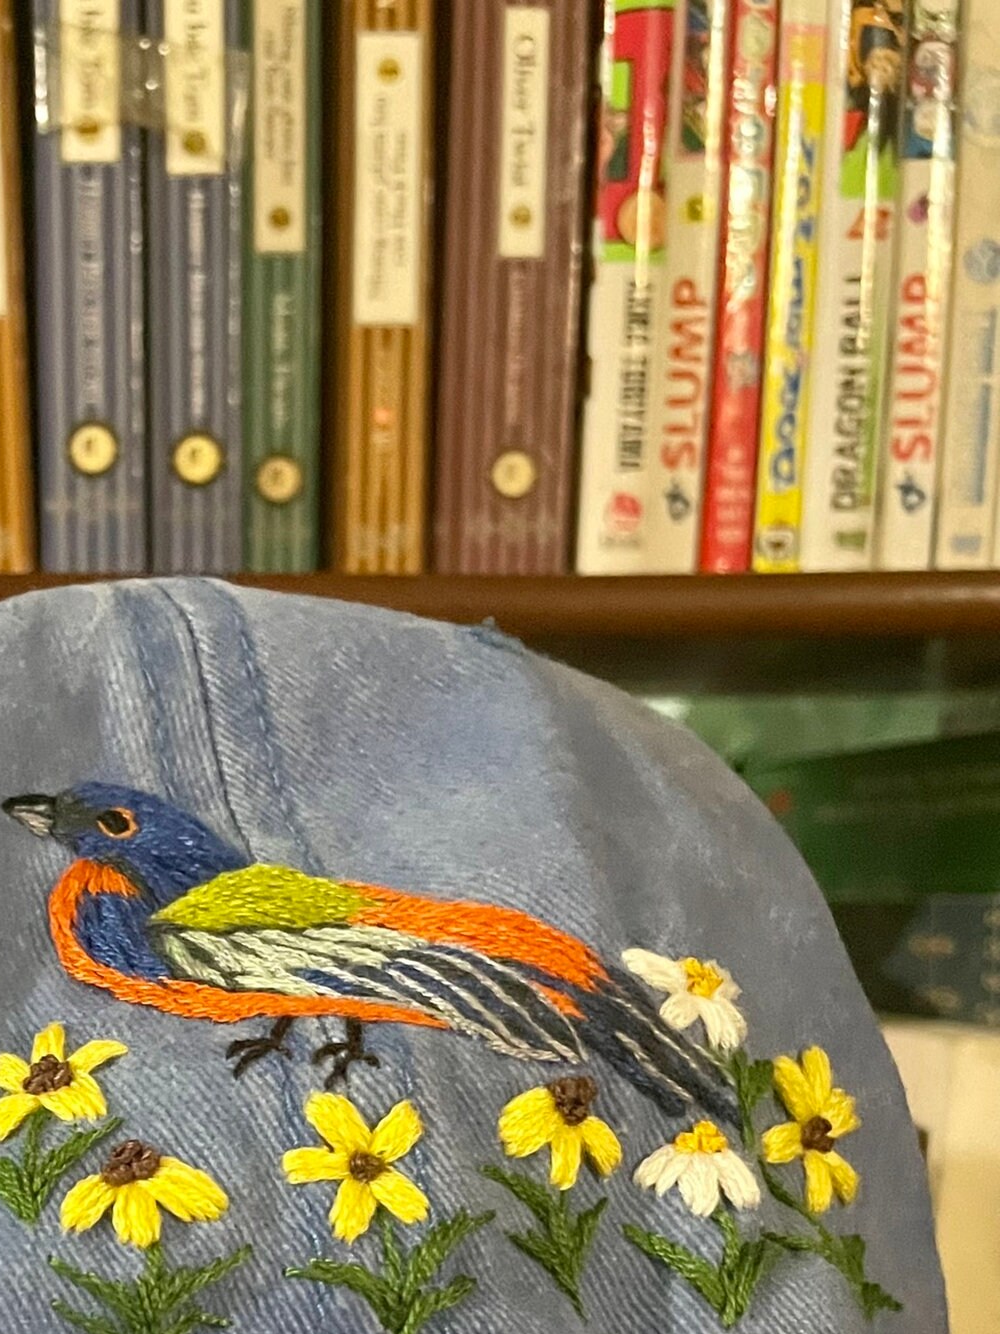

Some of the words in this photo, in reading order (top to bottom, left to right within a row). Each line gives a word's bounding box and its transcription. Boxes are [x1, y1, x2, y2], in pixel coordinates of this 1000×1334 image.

[659, 277, 708, 471] SLUMP
[829, 366, 867, 512] DRAGON
[890, 274, 940, 463] SLUMP
